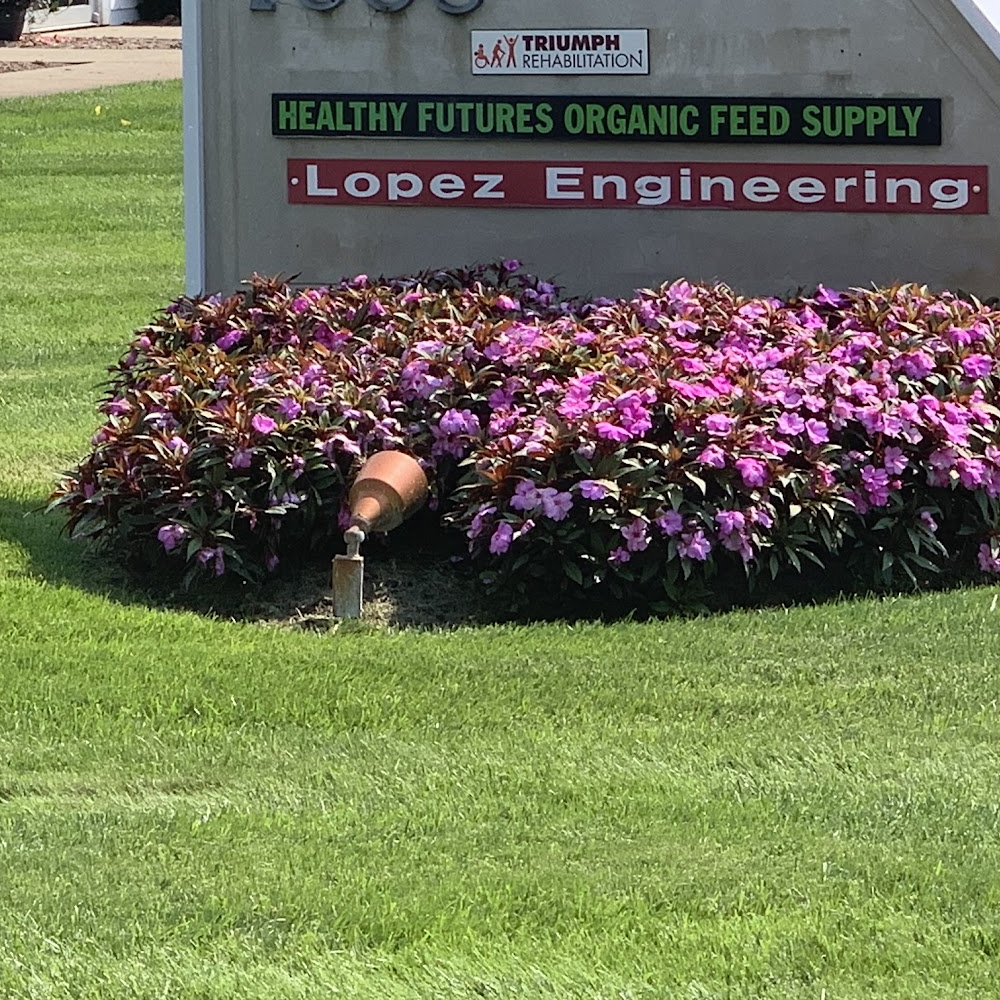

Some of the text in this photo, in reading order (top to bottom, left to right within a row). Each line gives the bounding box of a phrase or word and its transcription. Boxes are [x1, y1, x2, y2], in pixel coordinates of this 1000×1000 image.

[522, 34, 620, 51] TRIUMPH
[523, 53, 643, 69] REHABILITATION
[278, 100, 924, 137] HEALTHY FUTURES ORGANIC FEED SUPPLY
[306, 164, 969, 210] Lopez Engineering
